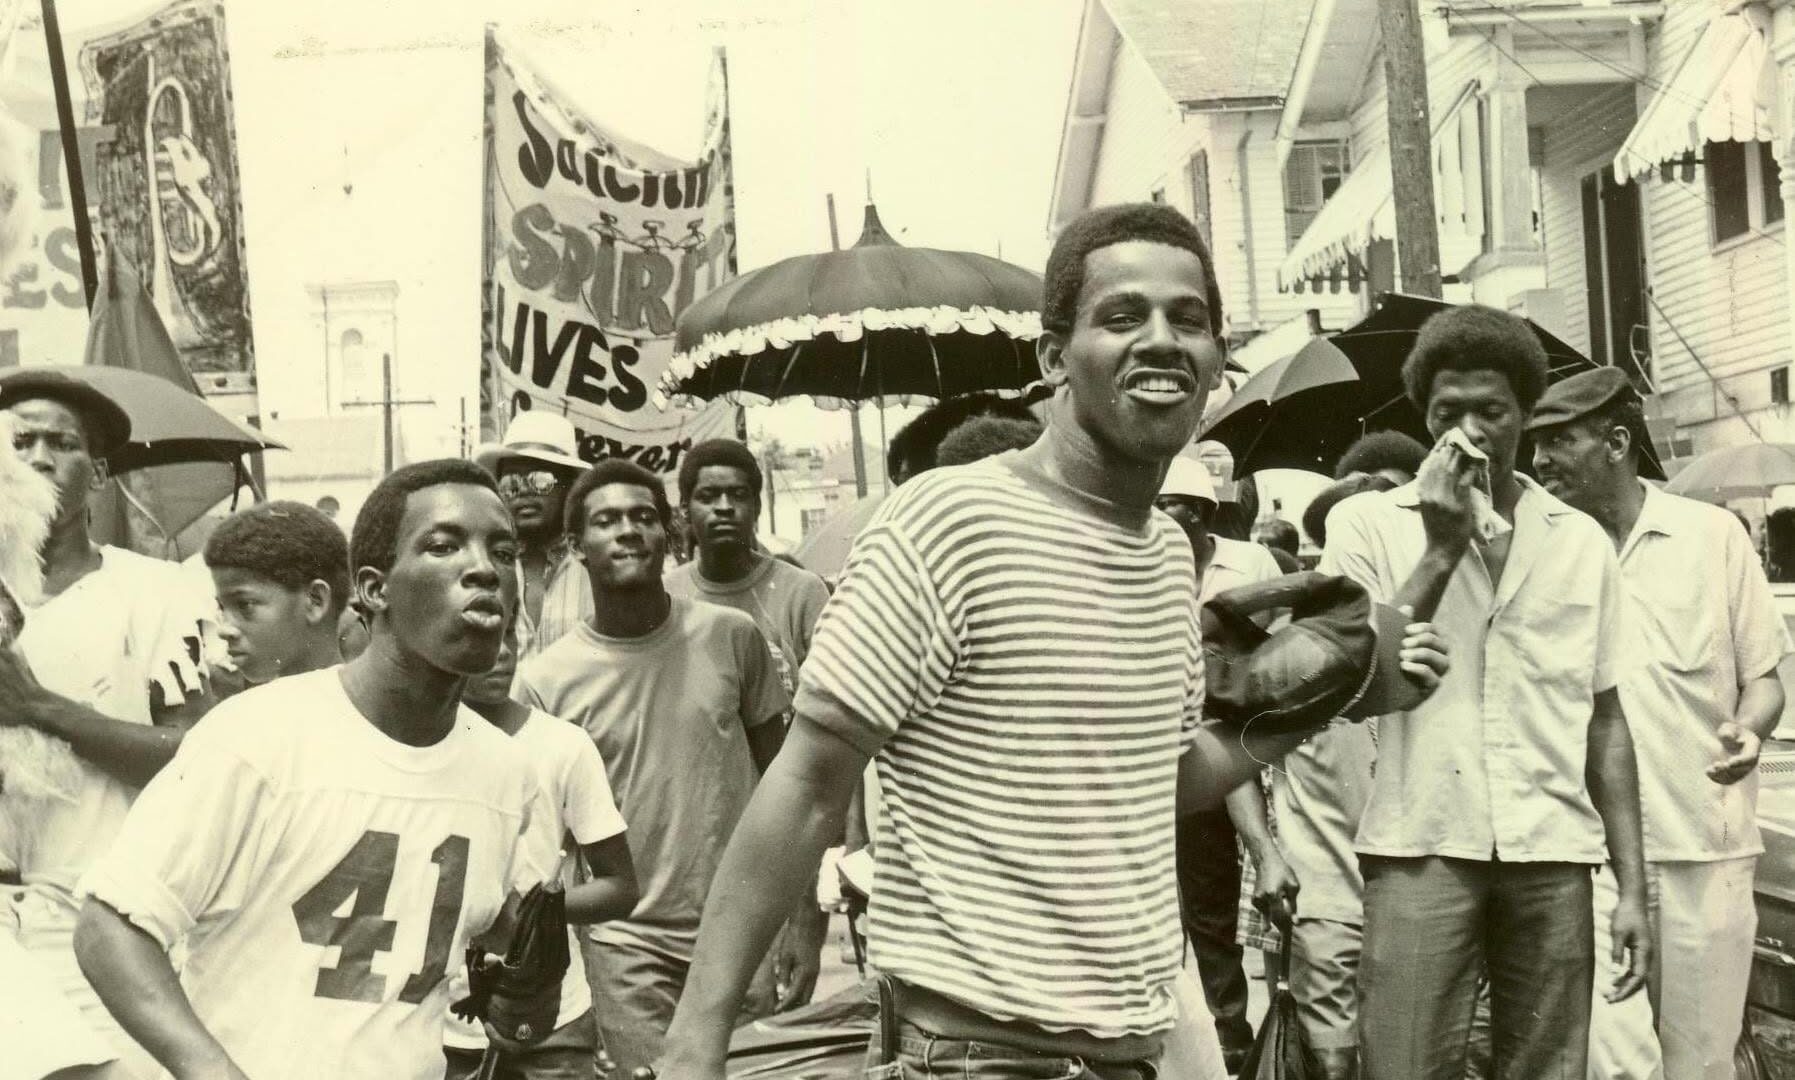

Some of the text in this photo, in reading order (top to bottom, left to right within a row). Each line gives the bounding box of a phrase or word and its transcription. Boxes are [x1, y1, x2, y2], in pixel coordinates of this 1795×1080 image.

[507, 203, 725, 336] SPIRIT
[496, 281, 648, 412] LIVES
[291, 829, 470, 1004] 41
